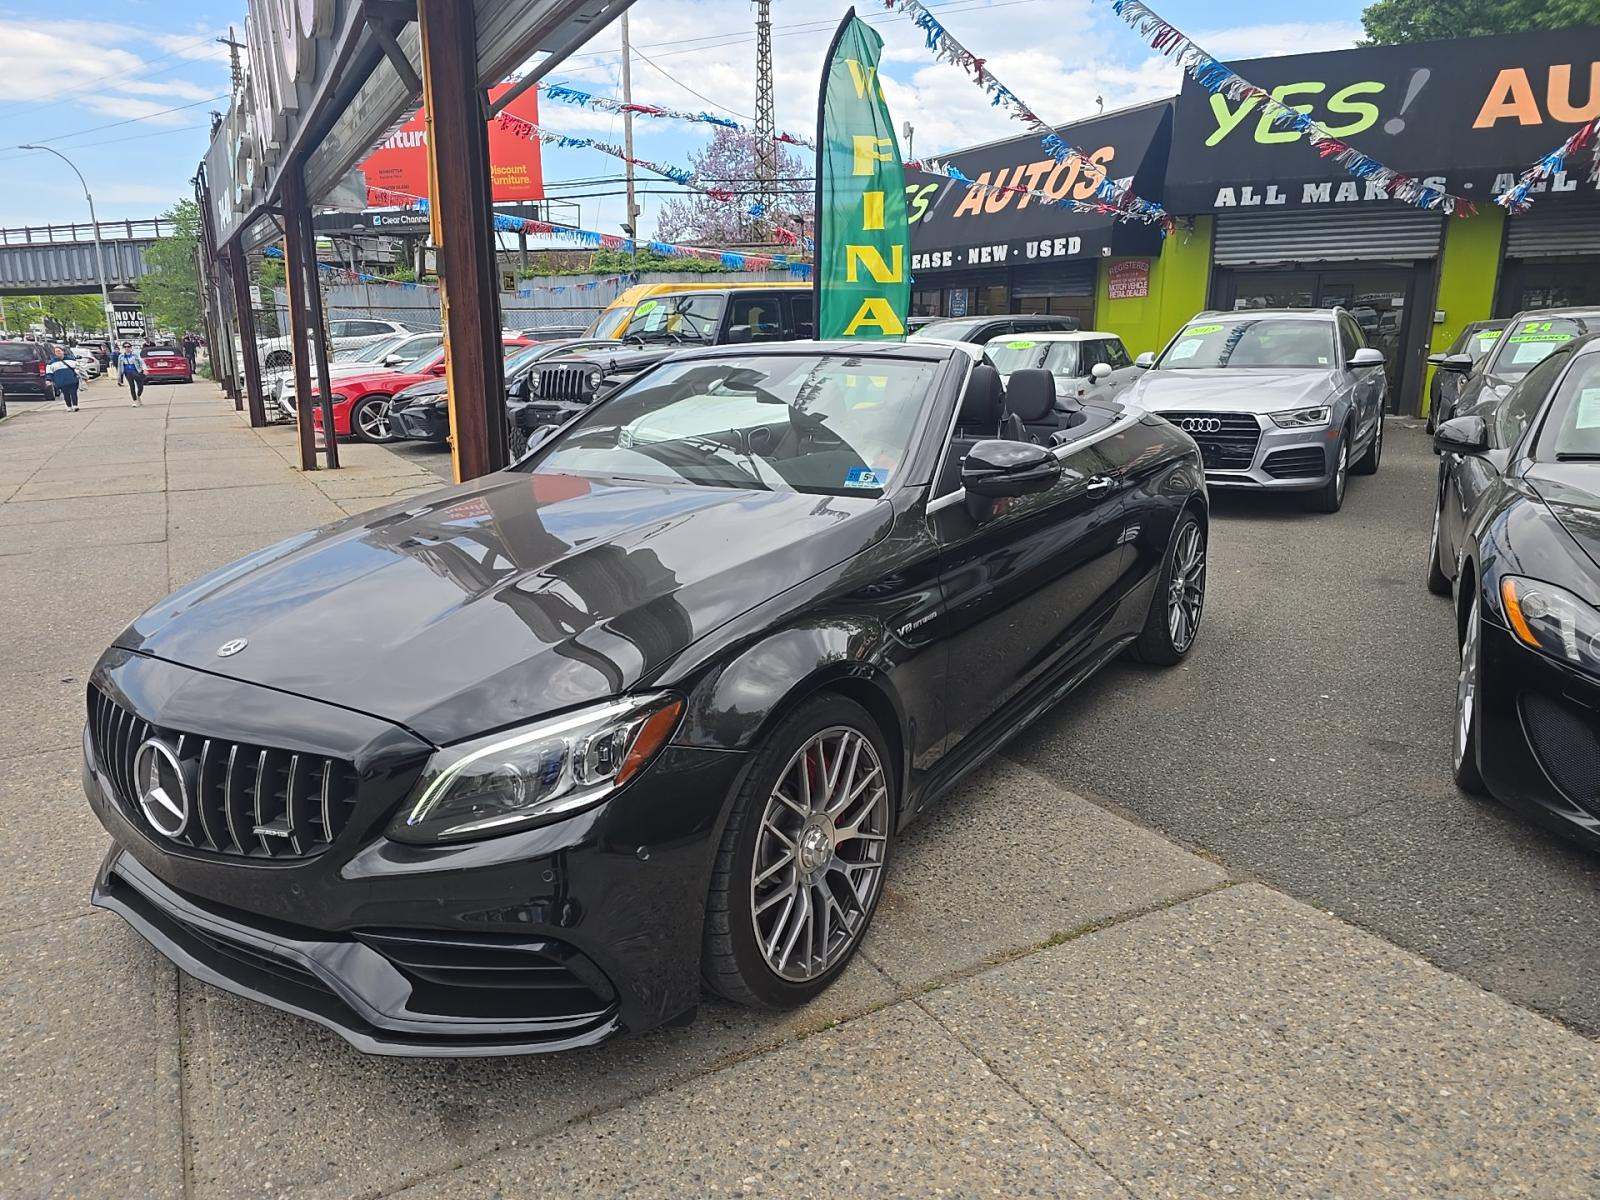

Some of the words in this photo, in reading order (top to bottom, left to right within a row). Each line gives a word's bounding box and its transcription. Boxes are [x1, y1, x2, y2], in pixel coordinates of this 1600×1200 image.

[1205, 68, 1431, 147] YES!
[953, 146, 1115, 218] AUTOS
[1213, 185, 1286, 207] ALL
[382, 216, 400, 224] Clear
[968, 245, 1008, 264] NEW
[1026, 236, 1081, 259] USED
[1522, 322, 1552, 334] 24
